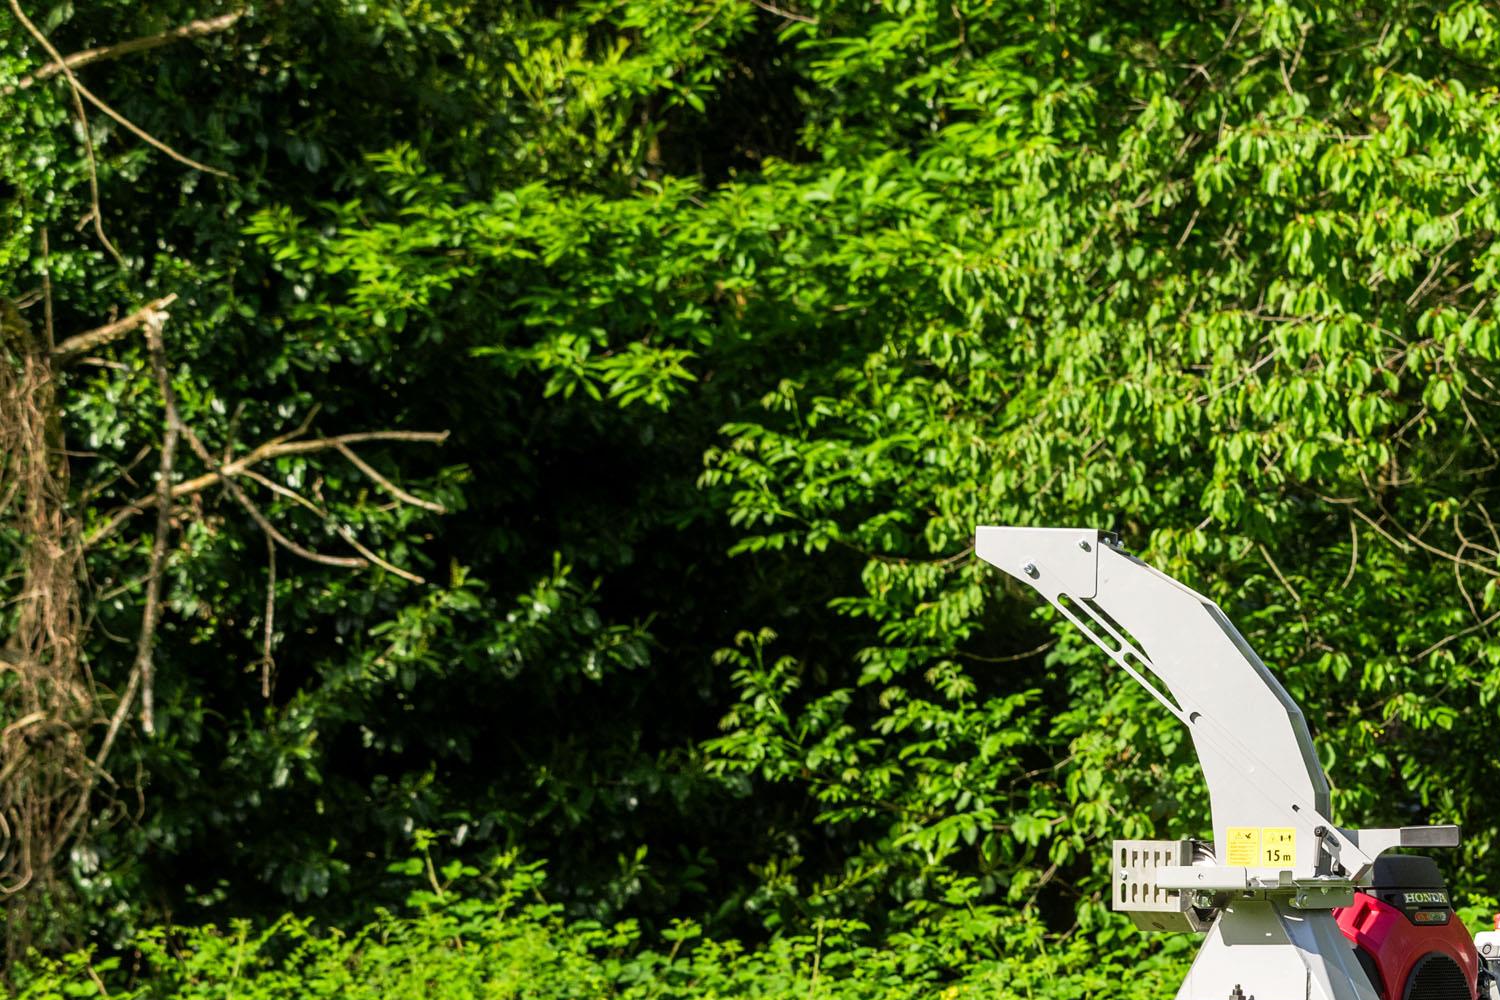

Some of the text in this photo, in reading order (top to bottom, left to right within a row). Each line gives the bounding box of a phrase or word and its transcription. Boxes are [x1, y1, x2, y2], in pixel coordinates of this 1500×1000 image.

[1266, 849, 1280, 862] 15
[1282, 854, 1291, 862] m
[1403, 891, 1448, 903] HONDA
